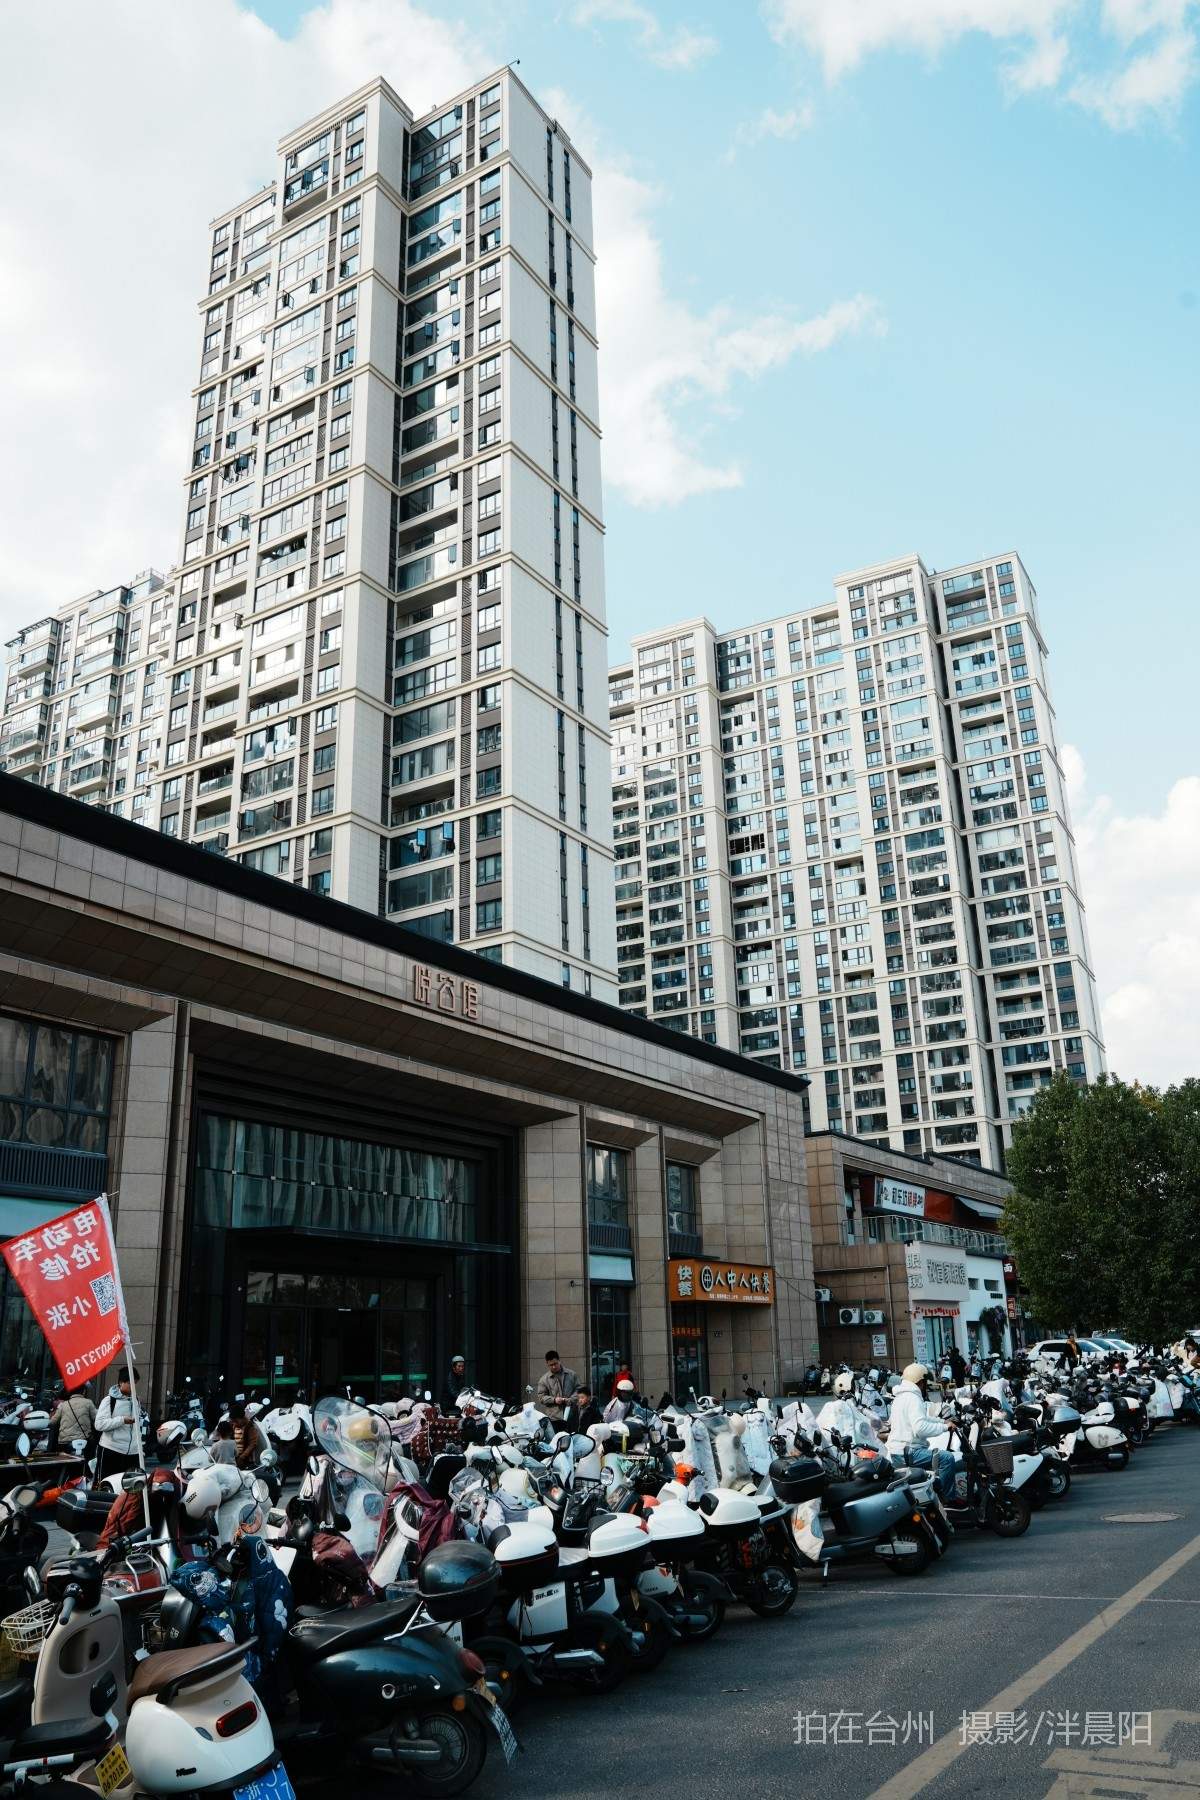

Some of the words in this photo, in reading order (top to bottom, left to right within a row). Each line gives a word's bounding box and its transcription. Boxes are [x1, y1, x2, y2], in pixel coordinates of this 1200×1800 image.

[677, 1265, 692, 1297] 快餐
[715, 1266, 771, 1294] 人中人快餐
